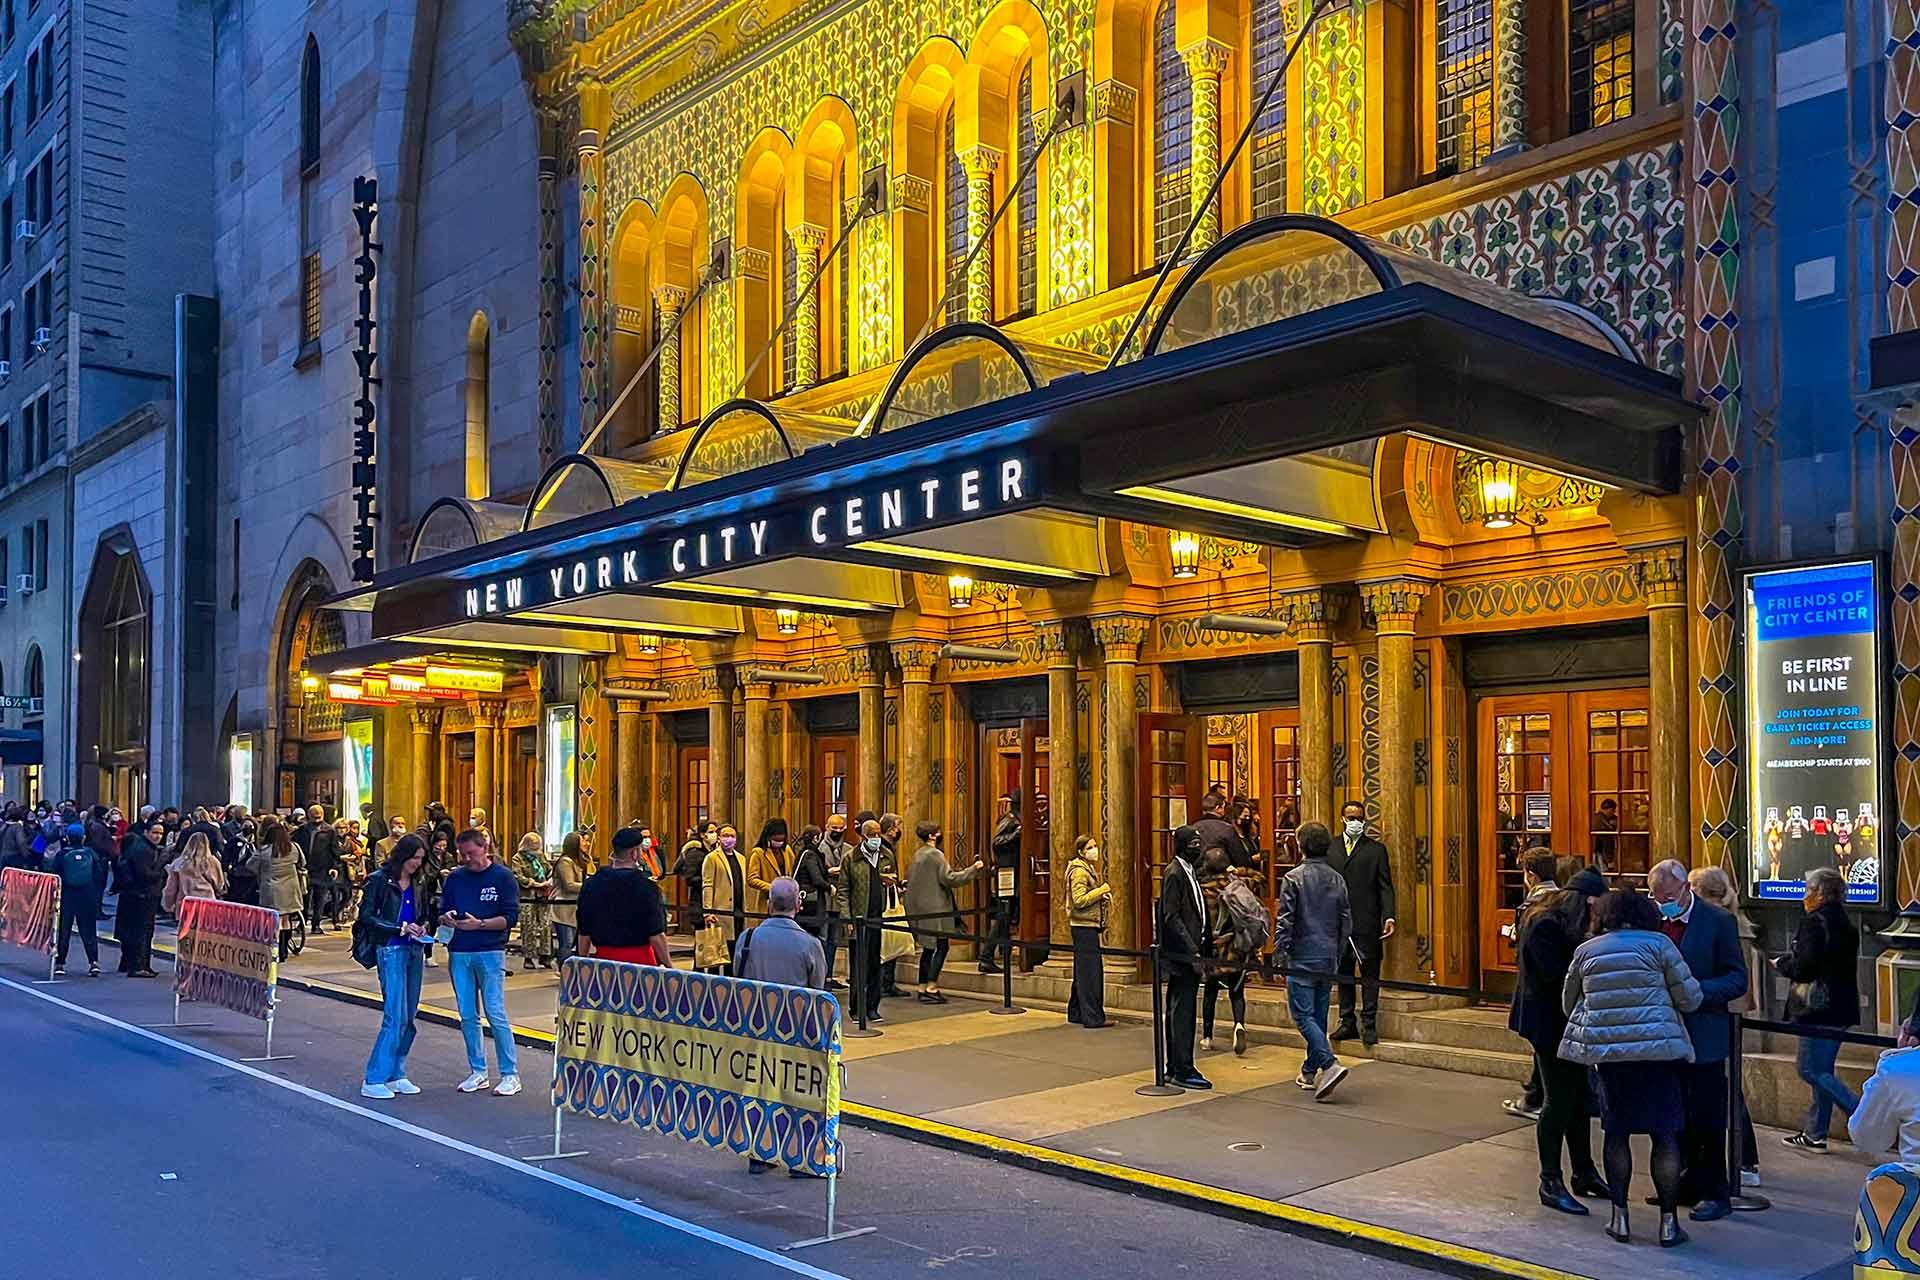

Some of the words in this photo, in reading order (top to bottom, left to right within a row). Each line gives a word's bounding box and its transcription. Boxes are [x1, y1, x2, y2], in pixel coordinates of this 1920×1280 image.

[466, 577, 522, 617] NEW
[550, 550, 639, 599] YORK
[671, 519, 767, 573] CITY
[810, 458, 1023, 545] CENTER
[1767, 592, 1837, 611] FRIENDS
[1841, 590, 1865, 604] OF
[1764, 613, 1799, 627] CITY
[1804, 606, 1868, 623] CENTER
[1782, 660, 1803, 674] BE
[1806, 656, 1852, 673] FIRST
[1787, 679, 1805, 693] IN
[1809, 676, 1848, 692] LINE
[1776, 709, 1800, 719] JOIN
[1802, 707, 1835, 717] TODAY
[1836, 706, 1859, 716] FOR
[1765, 723, 1795, 733] EARLY
[1797, 721, 1830, 732] TICKET
[1832, 720, 1872, 730] ACCESS
[1790, 736, 1811, 745] AND
[1813, 735, 1846, 745] MORE!
[1766, 759, 1816, 767] MEMBERSHIP
[1816, 758, 1843, 766] STARTS
[1844, 758, 1853, 766] AT
[219, 943, 238, 965] CITY
[562, 1019, 605, 1051] NEW
[612, 1026, 665, 1062] YORK
[673, 1039, 722, 1074] CITY
[730, 1050, 823, 1098] CENTER
